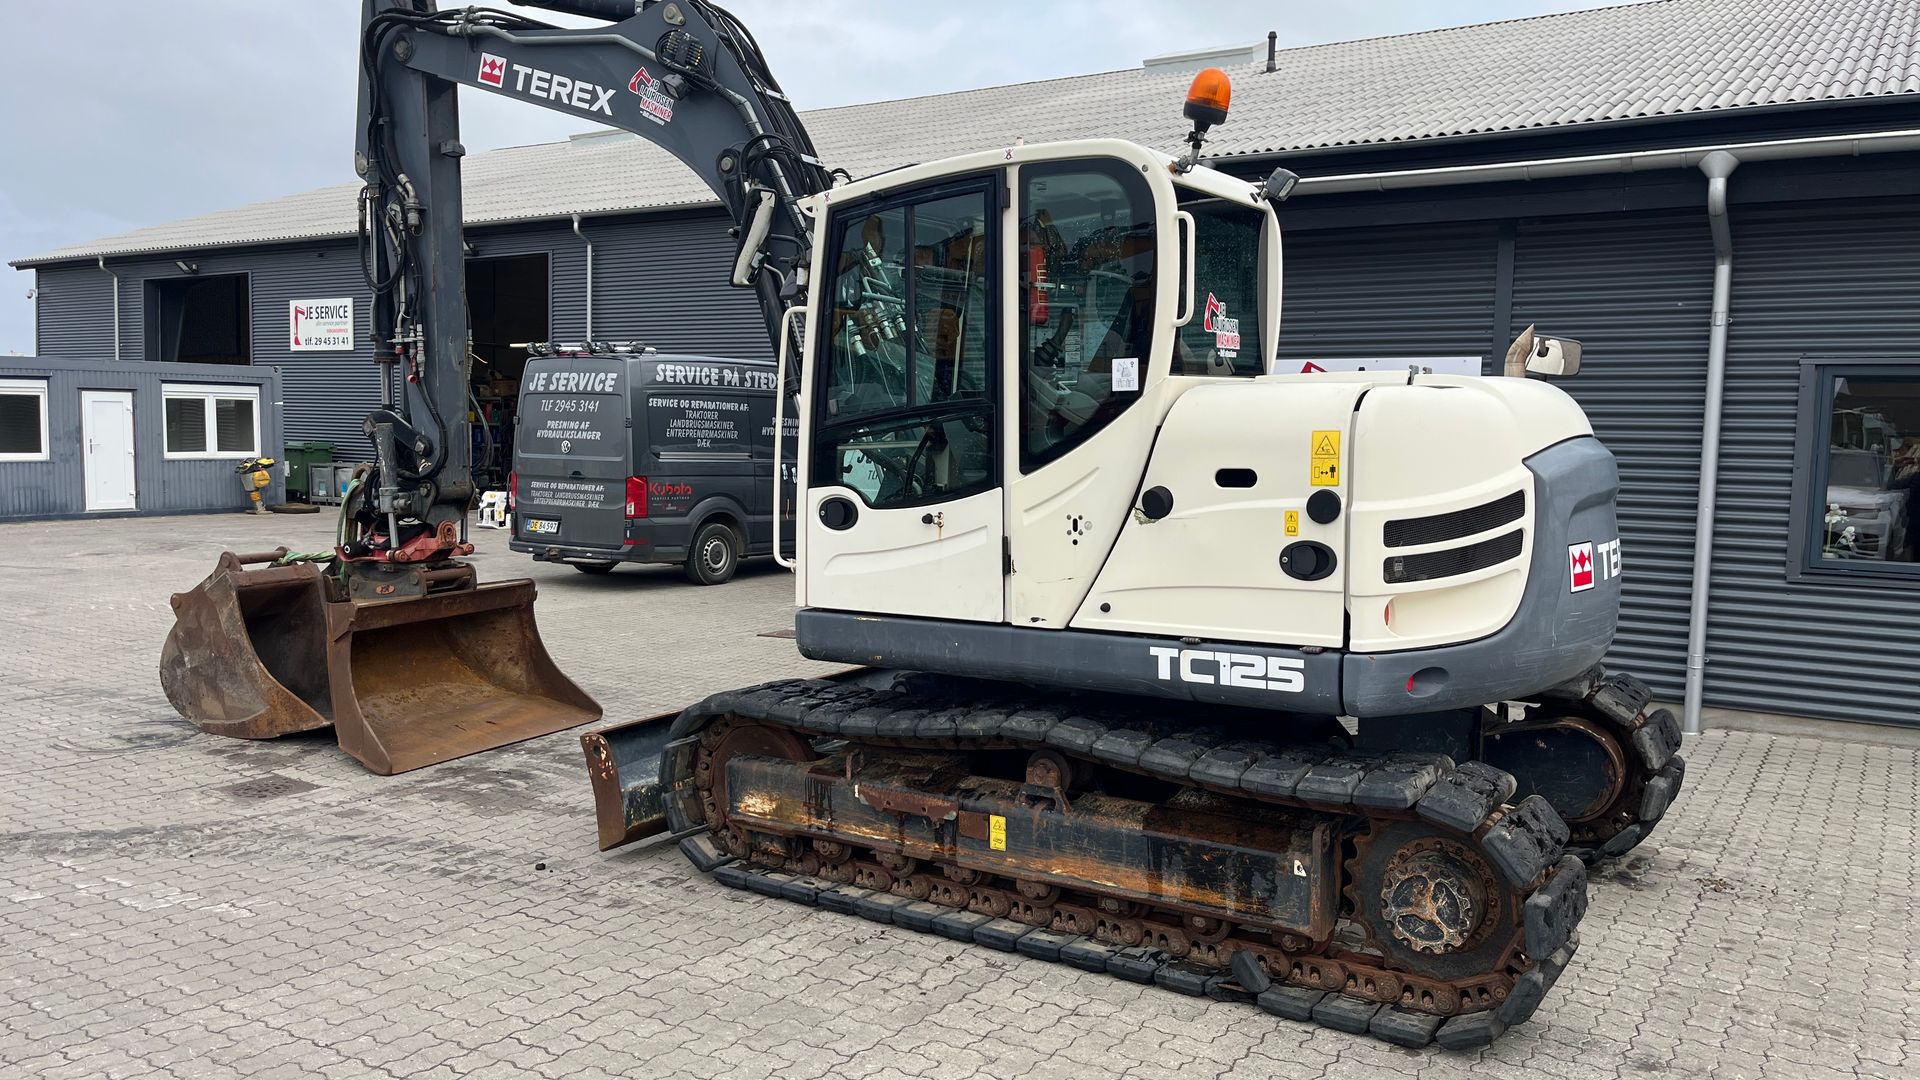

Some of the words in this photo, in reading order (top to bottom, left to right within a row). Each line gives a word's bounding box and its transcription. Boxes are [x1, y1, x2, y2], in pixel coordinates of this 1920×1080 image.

[512, 63, 617, 116] TEREX
[639, 84, 674, 110] LAURIDSEN
[640, 97, 673, 122] MASKINER
[305, 306, 313, 320] JE
[315, 305, 348, 319] SERVICE
[305, 337, 313, 345] tlf.
[315, 337, 322, 345] 29
[323, 337, 331, 345] 45
[332, 337, 340, 345] 31
[341, 337, 349, 345] 41
[1217, 332, 1240, 349] MASKINER
[656, 363, 719, 385] SERVICE
[723, 366, 740, 387] PÅ
[529, 372, 548, 391] JE
[549, 372, 617, 392] SERVICE
[541, 399, 553, 411] TLF
[555, 399, 576, 412] 2945
[579, 400, 599, 412] 3141
[649, 398, 678, 408] SERVICE
[680, 399, 689, 408] OG
[691, 400, 739, 411] REPARATIONER
[685, 410, 718, 420] TRAKTORER
[547, 420, 580, 430] PRESNING
[580, 421, 590, 430] AF
[670, 419, 734, 430] LANDBRUGSMASKINER
[536, 429, 602, 440] HYDRAULIKSLANGER
[666, 429, 738, 439] ENTREPRENØRMASKINER
[697, 439, 711, 447] DÆK
[531, 481, 549, 489] SERVICE
[557, 483, 595, 491] REPARATIONER
[649, 482, 693, 495] Kubota
[1150, 646, 1304, 693] TC125
